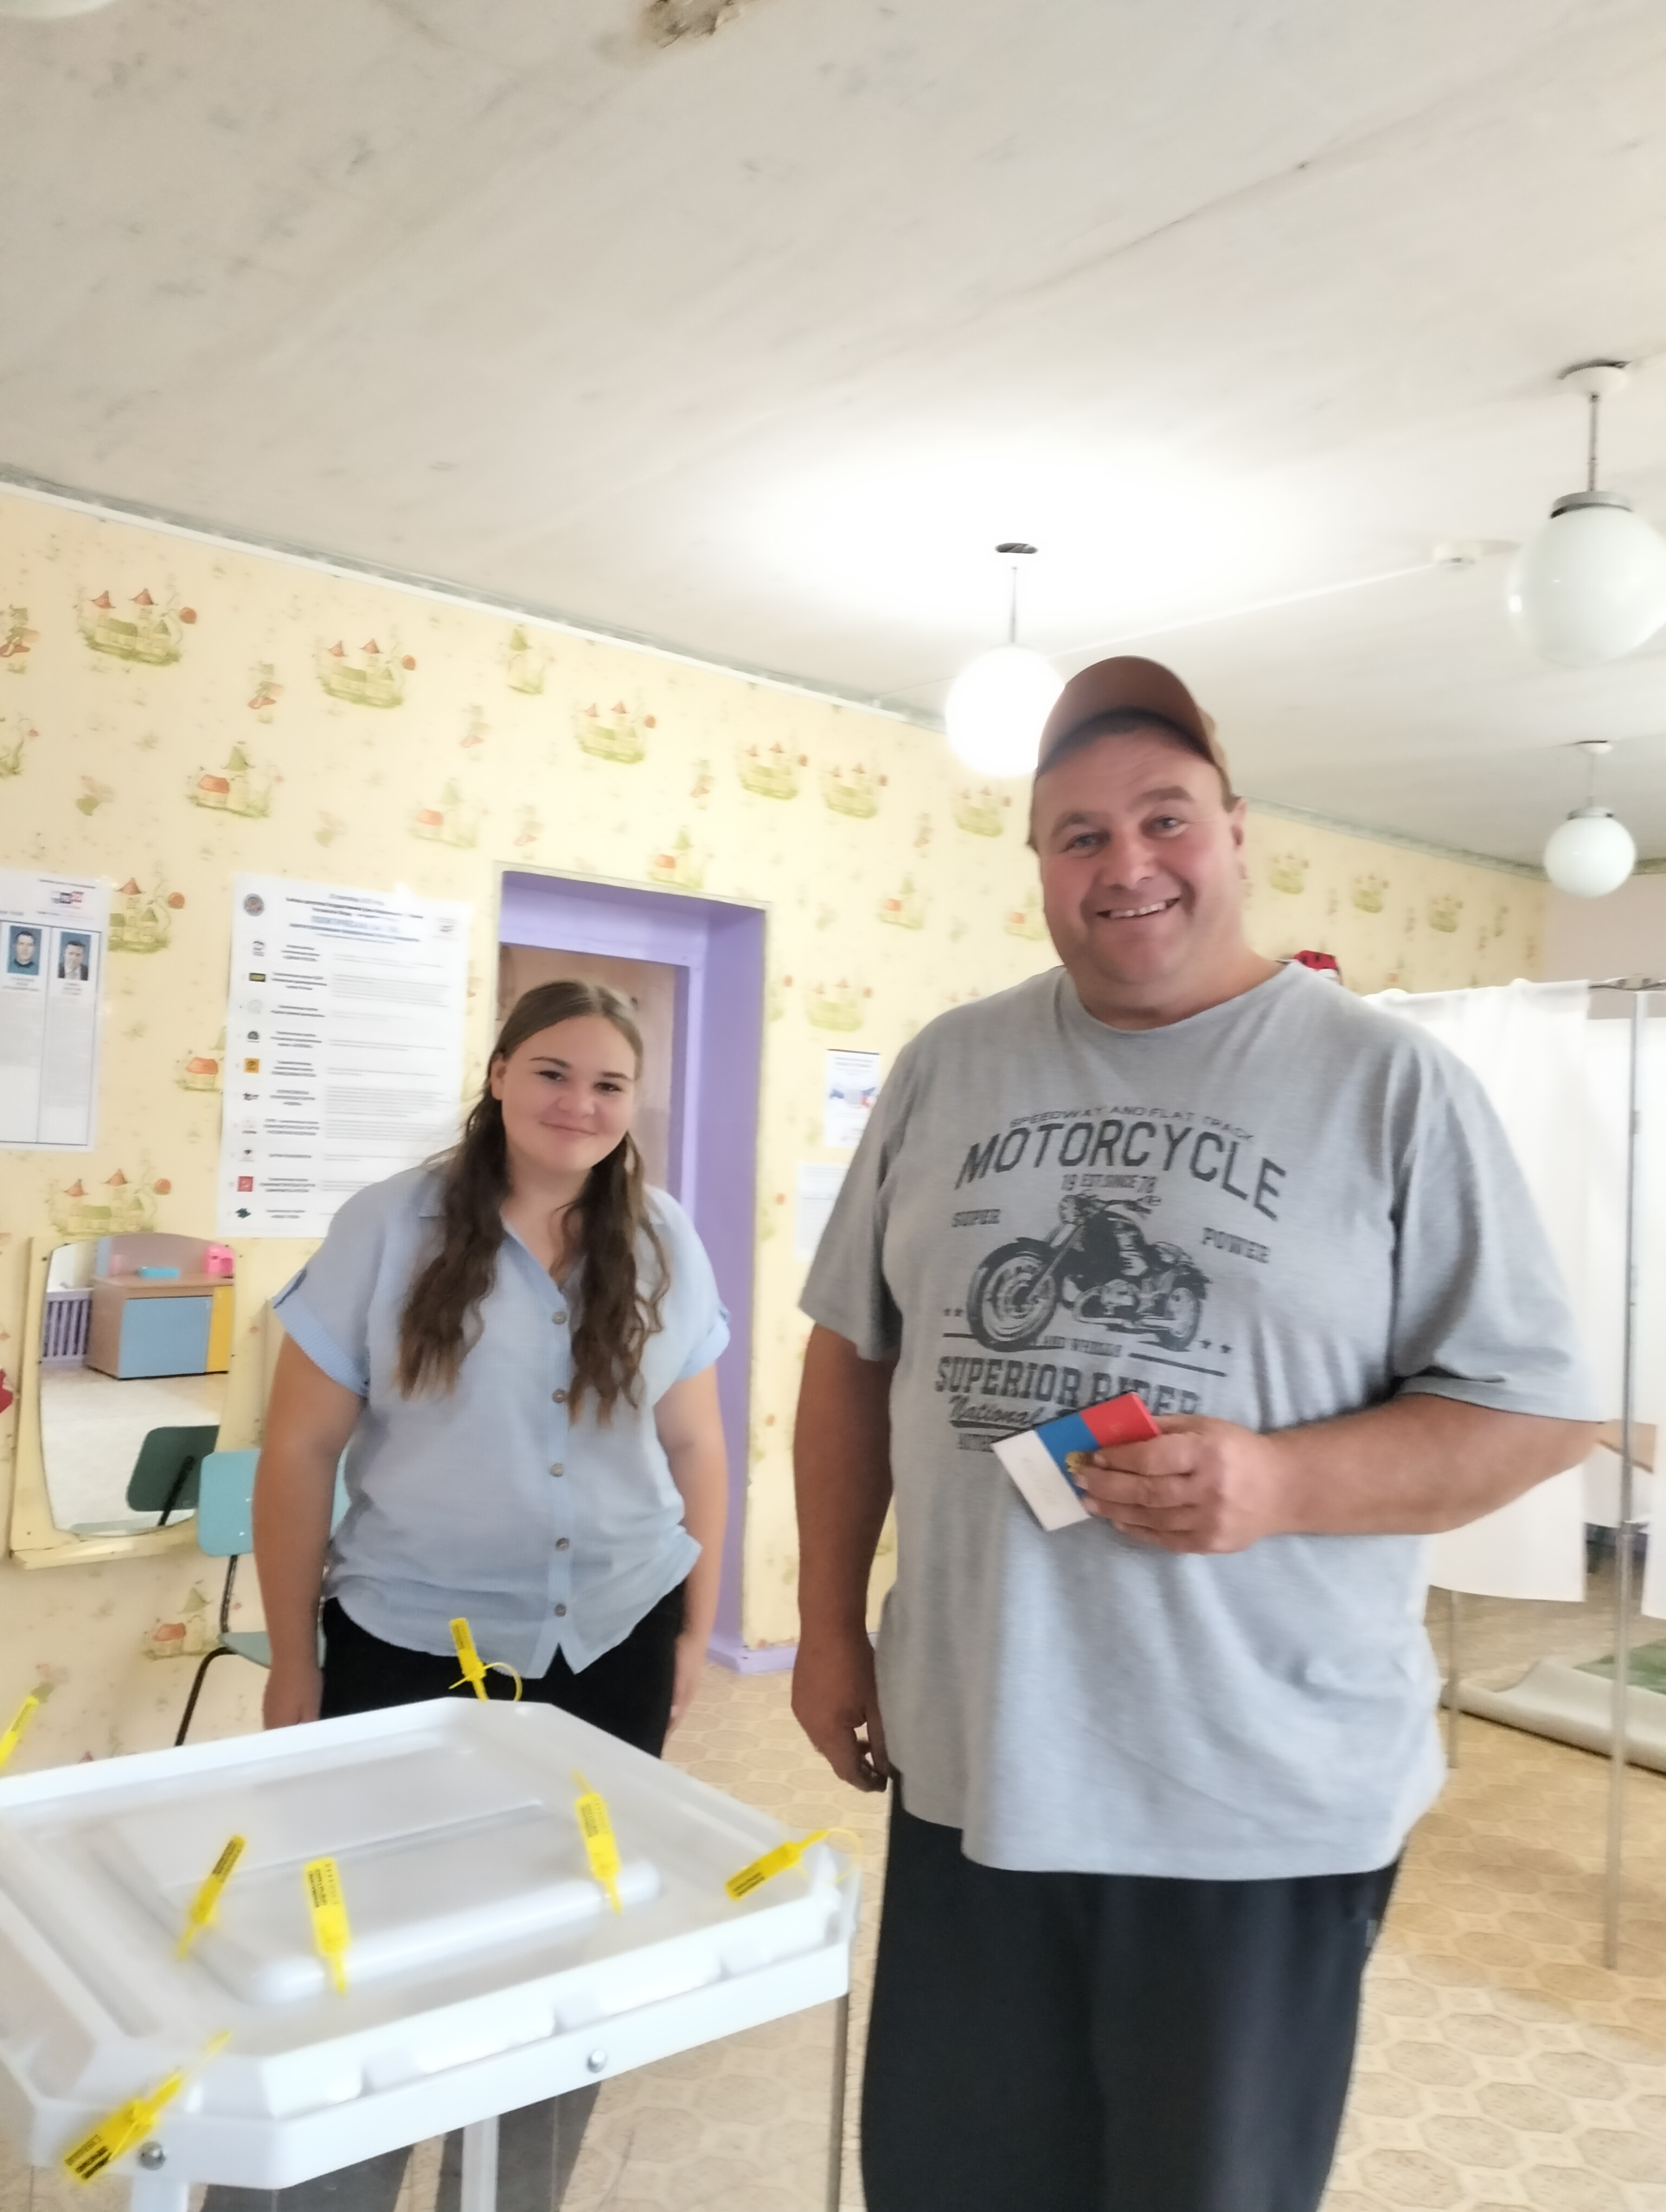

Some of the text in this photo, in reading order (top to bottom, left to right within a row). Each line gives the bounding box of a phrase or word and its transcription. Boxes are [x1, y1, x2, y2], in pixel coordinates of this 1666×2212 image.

[1009, 1107, 1103, 1128] SPEEDWAY
[1110, 1105, 1143, 1117] AND
[1148, 1108, 1196, 1122] FLAT
[953, 1119, 1287, 1221] MOTORCYCLE
[935, 1355, 1081, 1409] SUPERIOR
